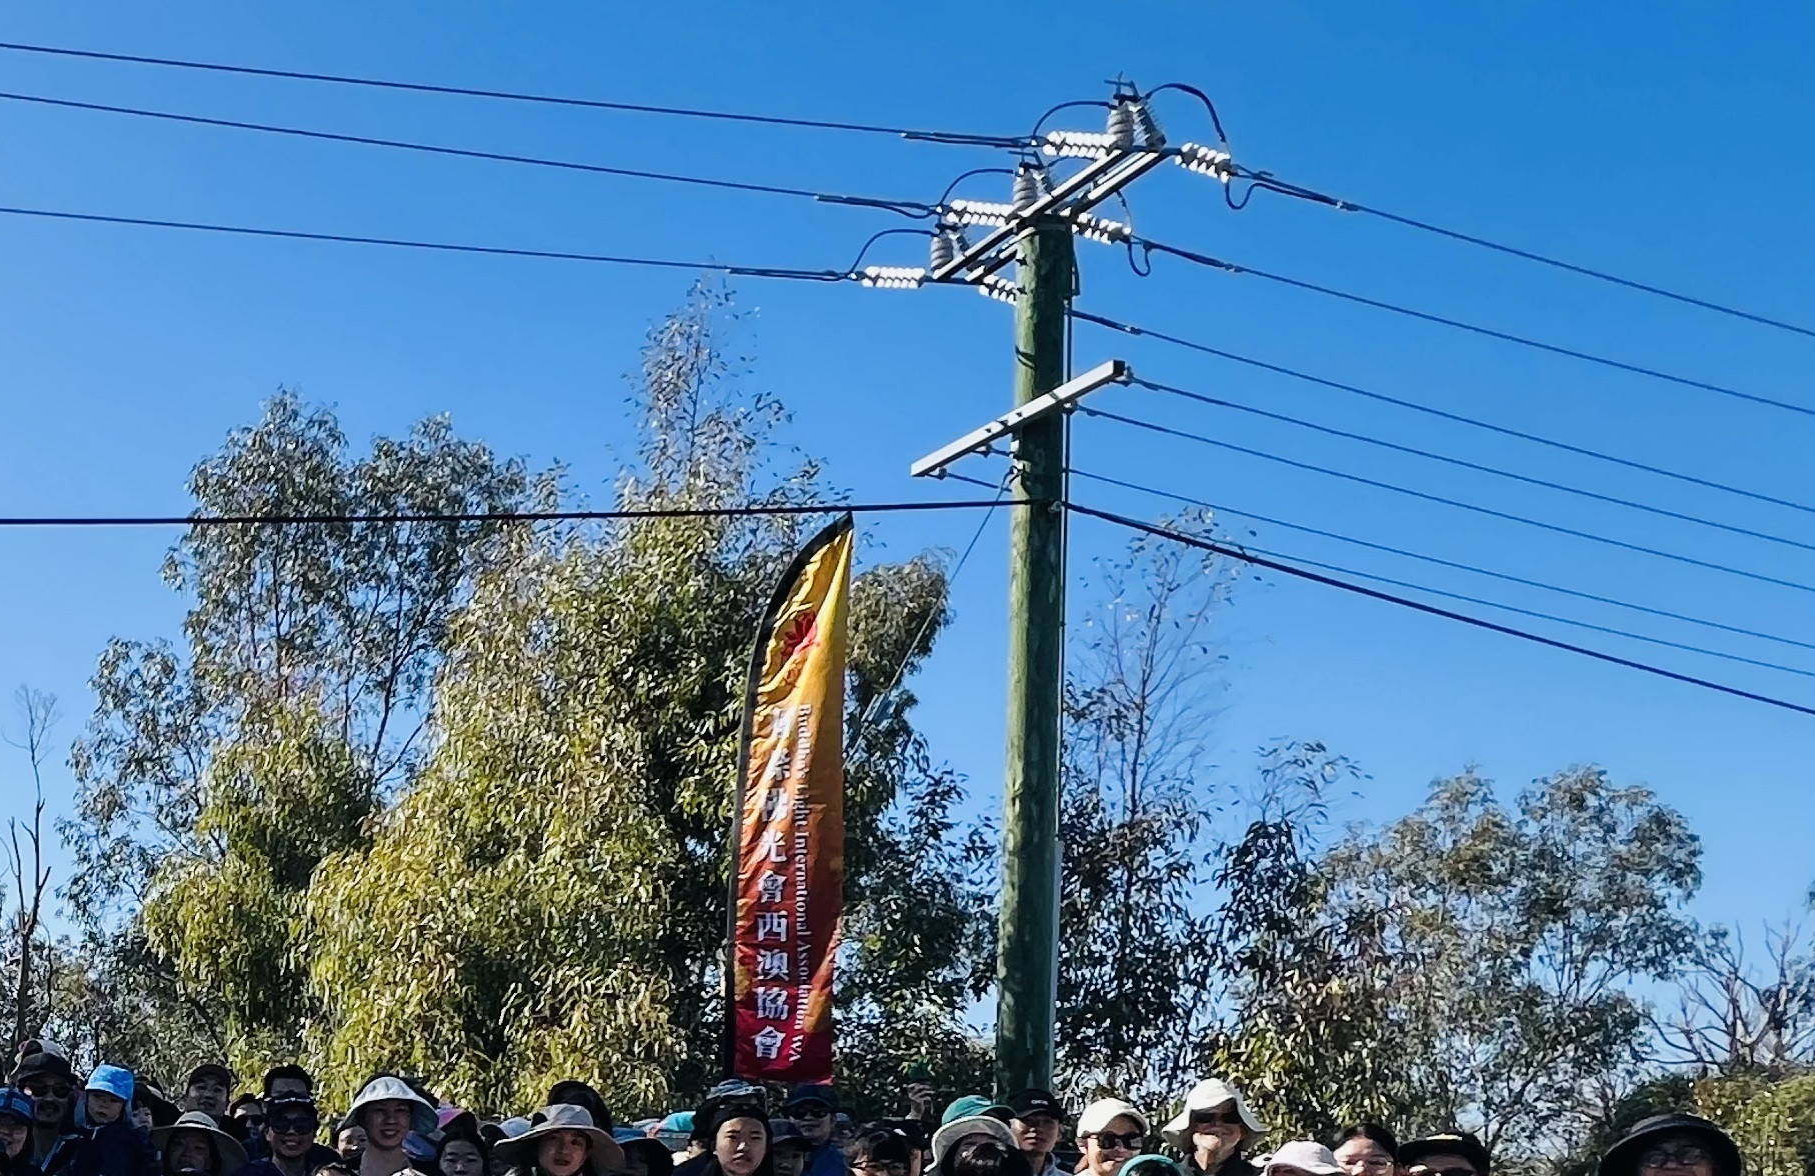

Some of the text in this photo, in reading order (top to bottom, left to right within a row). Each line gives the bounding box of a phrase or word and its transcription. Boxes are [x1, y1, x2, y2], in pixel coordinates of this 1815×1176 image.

[793, 784, 810, 826] Light
[795, 832, 811, 936] International
[794, 940, 812, 1030] Association
[788, 1034, 804, 1062] WA
